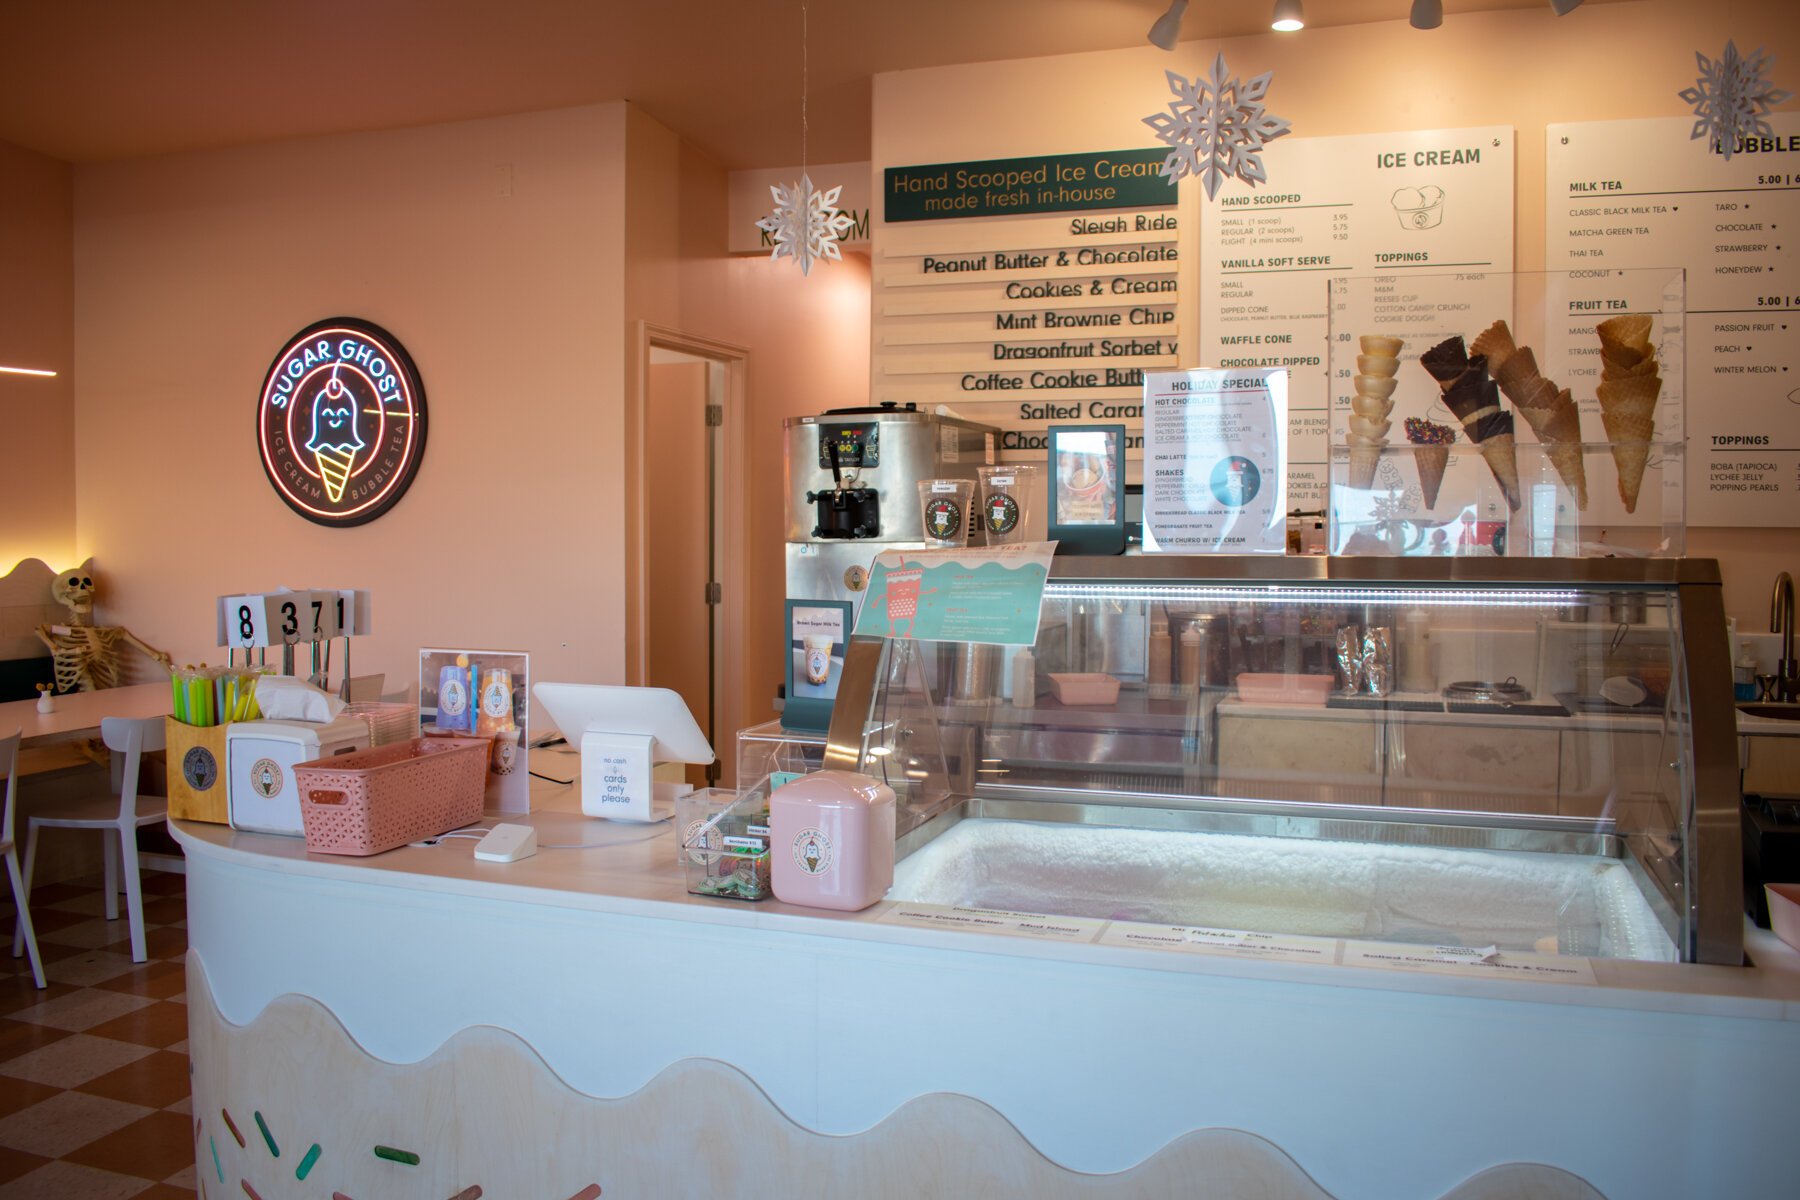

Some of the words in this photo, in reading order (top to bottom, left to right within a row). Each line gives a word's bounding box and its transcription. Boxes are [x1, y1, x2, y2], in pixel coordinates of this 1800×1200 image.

[1377, 152, 1407, 169] ICE
[1413, 148, 1481, 167] CREAM
[894, 171, 949, 194] Hand
[955, 165, 1048, 190] Scooped
[1055, 162, 1087, 182] Ice
[1094, 159, 1166, 180] Cream
[1757, 174, 1782, 185] 5.00
[1569, 181, 1597, 192] MILK
[1600, 180, 1623, 191] TEA
[925, 190, 979, 212] made
[985, 187, 1031, 208] fresh
[1036, 184, 1117, 205] in-house
[1221, 196, 1250, 206] HAND
[1253, 193, 1301, 205] SCOOPED
[1569, 208, 1602, 217] CLASSIC
[1603, 206, 1629, 216] BLACK
[1631, 205, 1651, 215] MILK
[1652, 205, 1668, 214] TEA
[1715, 203, 1738, 212] TARO
[1221, 218, 1244, 226] SMALL
[1257, 217, 1282, 226] scoop)
[1332, 213, 1349, 222] 3.95
[1070, 217, 1128, 236] Sleigh
[1135, 213, 1178, 231] Ride
[1332, 223, 1349, 231] 5.75
[1715, 223, 1764, 233] CHOCOLATE
[1221, 227, 1254, 236] REGULAR
[1267, 226, 1295, 235] scoops)
[1569, 228, 1604, 238] MATCHA
[1605, 227, 1633, 236] GREEN
[1634, 226, 1650, 236] TEA
[1221, 237, 1246, 246] FLIGHT
[1332, 233, 1349, 241] 9.50
[1569, 249, 1588, 258] THAI
[1588, 249, 1605, 258] TEA
[1714, 244, 1769, 254] STRAWBERRY
[923, 254, 987, 274] Peanut
[994, 252, 1049, 271] Butter
[1055, 250, 1070, 268] &
[1077, 245, 1179, 266] Chocolate
[1220, 258, 1265, 269] VANILLA
[1267, 257, 1294, 268] SOFT
[1297, 255, 1332, 265] SERVE
[1374, 252, 1429, 263] TOPPINGS
[1568, 269, 1611, 279] COCONUT
[1714, 265, 1764, 275] HONEYDEW
[1005, 280, 1082, 300] Cookies
[1089, 279, 1104, 296] &
[1110, 276, 1178, 295] Cream
[1220, 281, 1244, 289] SMALL
[1220, 290, 1254, 299] REGULAR
[1568, 300, 1604, 311] FRUIT
[1605, 299, 1628, 310] TEA
[1757, 296, 1782, 307] 5.00
[1220, 306, 1246, 314] DIPPED
[1247, 305, 1269, 314] CONE
[1436, 303, 1471, 313] CRUNCH
[995, 313, 1037, 331] Mint
[1044, 308, 1121, 328] Brownie
[1128, 306, 1175, 325] Chip
[1714, 323, 1751, 333] PASSION
[1752, 323, 1775, 332] FRUIT
[1220, 335, 1262, 345] WAFFLE
[1264, 334, 1293, 344] CONE
[993, 341, 1095, 361] Dragonfruit
[1100, 339, 1162, 358] Sorbet
[1568, 347, 1601, 356] STRAWB
[1714, 345, 1741, 353] PEACH
[1220, 356, 1280, 368] CHOCOLATE
[1282, 355, 1321, 366] DIPPED
[271, 339, 333, 410] SUGAR
[338, 339, 404, 403] GHOST
[1568, 368, 1598, 378] LYCHEE
[1714, 366, 1745, 375] WINTER
[1747, 365, 1778, 375] MELON
[960, 372, 1023, 392] Coffee
[1029, 369, 1098, 389] Cookie
[1154, 398, 1170, 406] HOT
[1171, 397, 1215, 406] CHOCOLATE
[1020, 402, 1081, 421] Salted
[1711, 435, 1770, 446] TOPPINGS
[274, 430, 287, 456] ICE
[283, 461, 321, 500] CREAM
[351, 458, 395, 500] BUBBLE
[390, 424, 405, 453] TEA
[1710, 463, 1734, 471] BOBA
[1735, 462, 1778, 472] (TAPIOCA)
[1154, 469, 1185, 477] SHAKES
[1710, 473, 1741, 482] LYCHEE
[1742, 473, 1763, 482] JELLY
[1710, 484, 1748, 493] POPPING
[1749, 483, 1779, 492] PEARLS
[280, 601, 299, 636] 3
[311, 601, 323, 633] 7
[336, 598, 346, 630] 1
[238, 604, 254, 640] 8
[612, 757, 627, 765] cash
[603, 774, 628, 784] cards
[607, 784, 625, 796] only
[601, 793, 631, 804] please
[794, 830, 811, 847] SUGAR
[812, 831, 831, 849] GHOST
